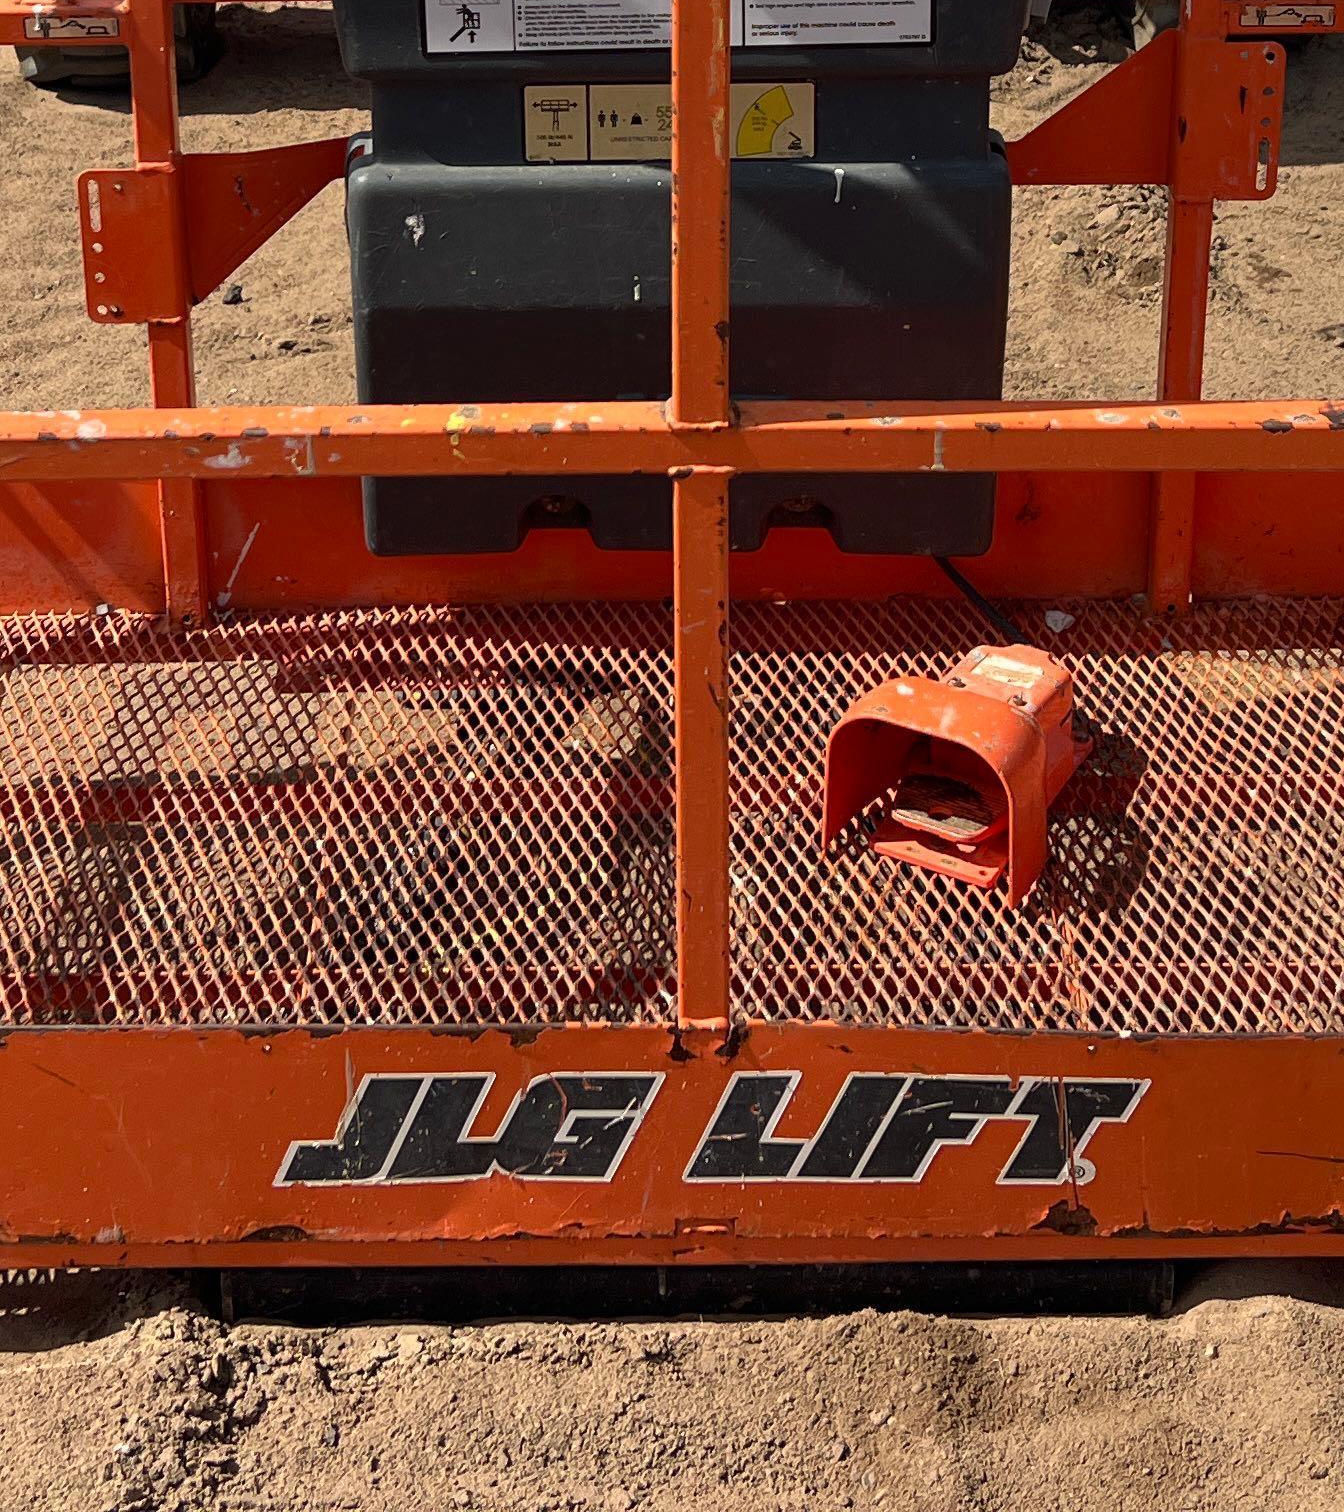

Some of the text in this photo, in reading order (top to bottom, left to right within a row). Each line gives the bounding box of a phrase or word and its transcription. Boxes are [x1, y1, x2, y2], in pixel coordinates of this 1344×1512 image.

[656, 105, 673, 119] 55
[272, 1070, 1152, 1186] JLG LIFT
